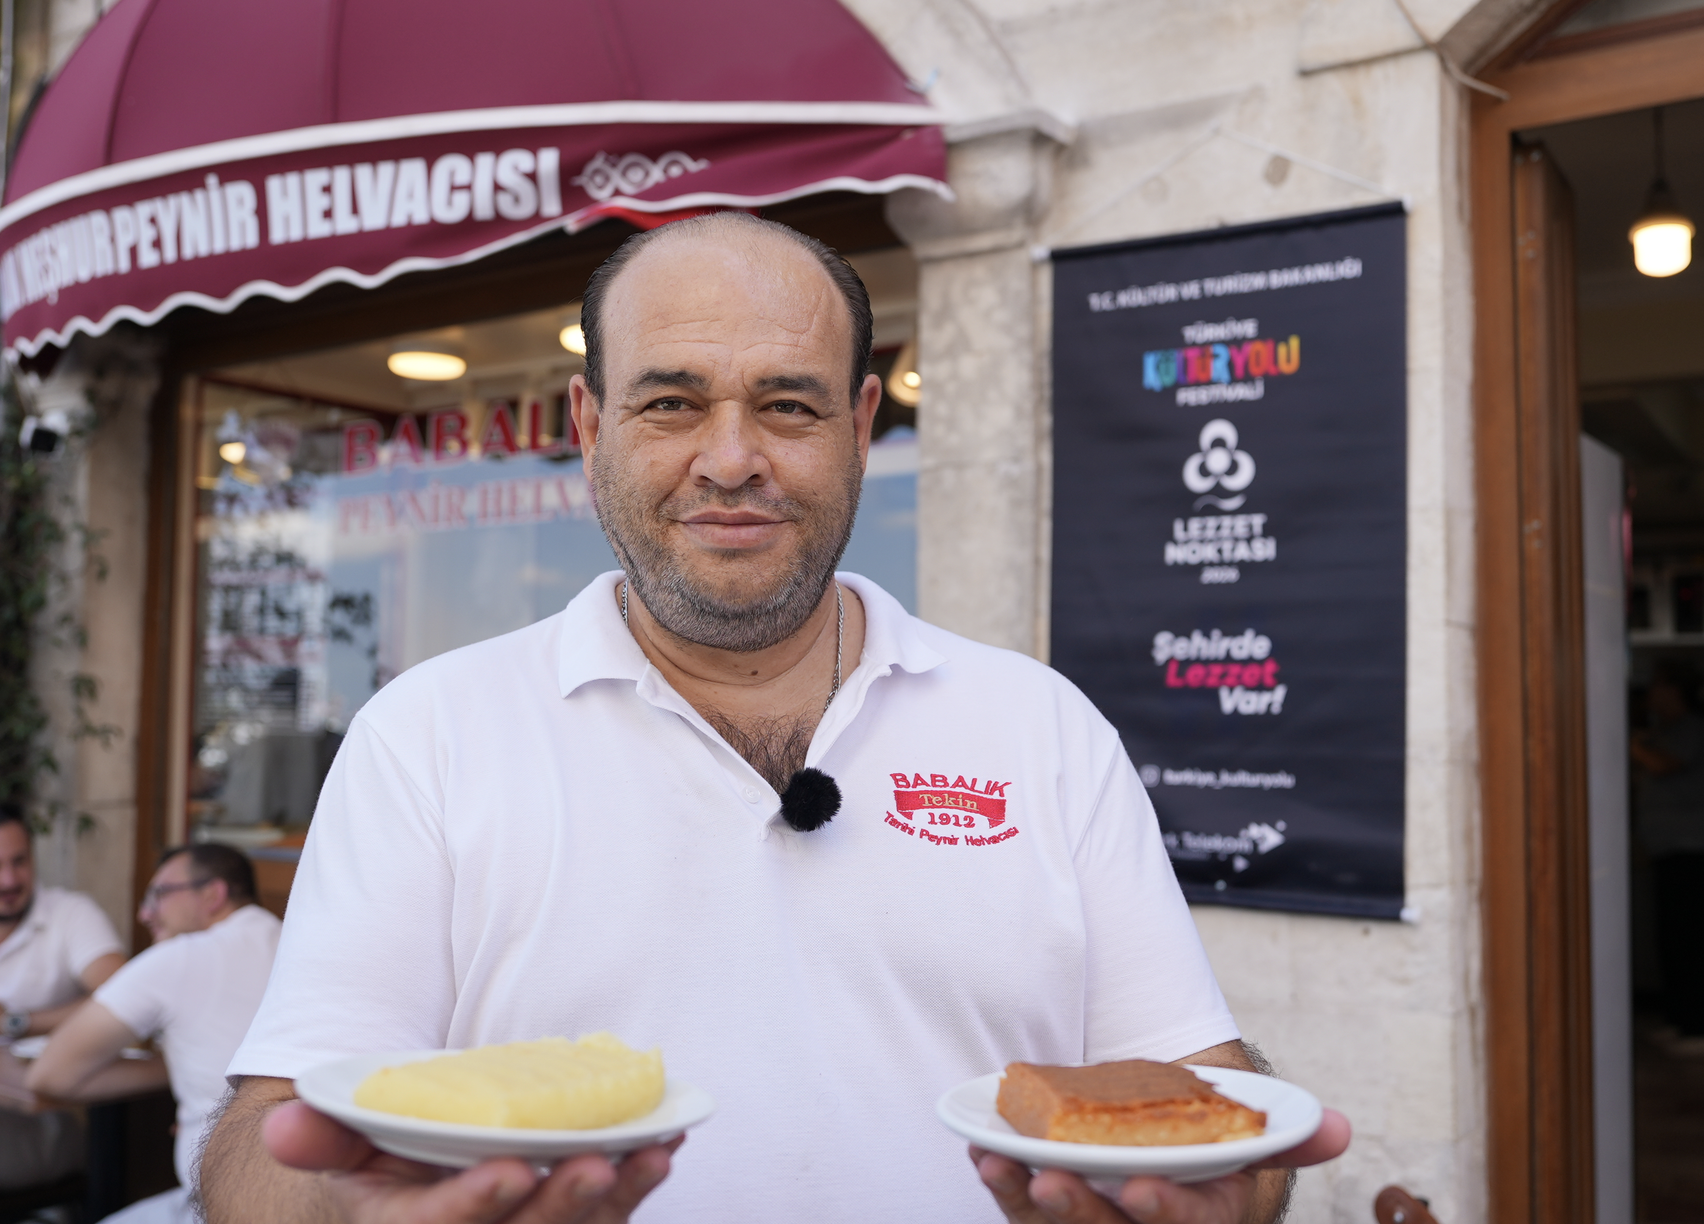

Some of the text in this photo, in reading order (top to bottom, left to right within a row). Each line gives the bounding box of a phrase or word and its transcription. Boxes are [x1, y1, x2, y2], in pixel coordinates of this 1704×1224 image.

[110, 172, 261, 275] PEYNİR
[265, 147, 563, 246] HELVACISI
[1116, 281, 1179, 308] KÜLTÜR
[1179, 279, 1202, 300] VE
[1268, 256, 1362, 290] BAKANLIĞI
[1173, 513, 1267, 542] LEZZET
[1164, 536, 1277, 565] NOKTASI
[1152, 628, 1272, 666] Şehirde
[1165, 658, 1280, 688] Lezzet
[1218, 684, 1287, 715] Var!
[890, 773, 1012, 797] BABALIK
[919, 793, 980, 811] Tekin
[884, 810, 1020, 847] Tarihi Peynir Helvacısı
[928, 812, 976, 828] 1912
